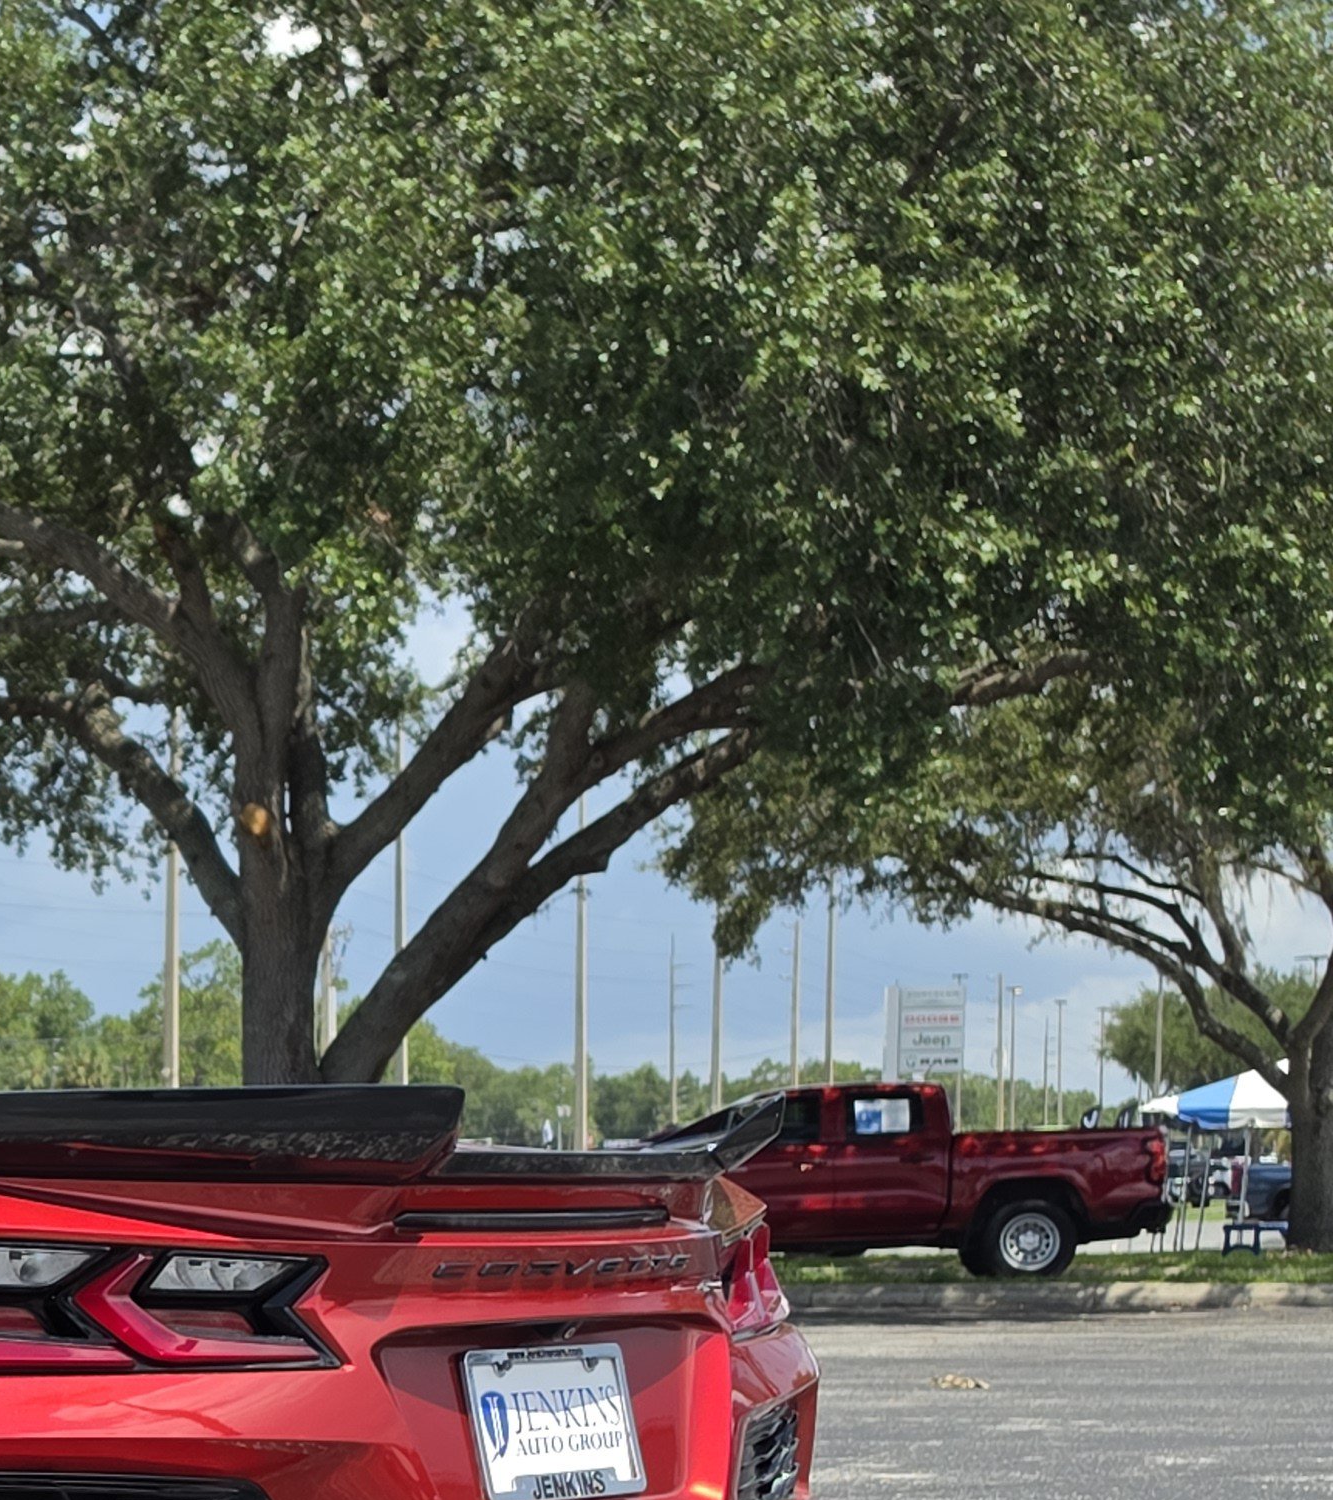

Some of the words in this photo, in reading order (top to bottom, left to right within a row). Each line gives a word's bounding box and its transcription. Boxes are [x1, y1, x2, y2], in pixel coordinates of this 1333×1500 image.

[912, 1032, 951, 1049] Jeep
[432, 1252, 691, 1279] CORVETTE
[511, 1385, 621, 1434] JENKINS
[517, 1436, 564, 1457] AUTO
[568, 1431, 623, 1452] GROUP
[533, 1471, 606, 1500] JENKINS
